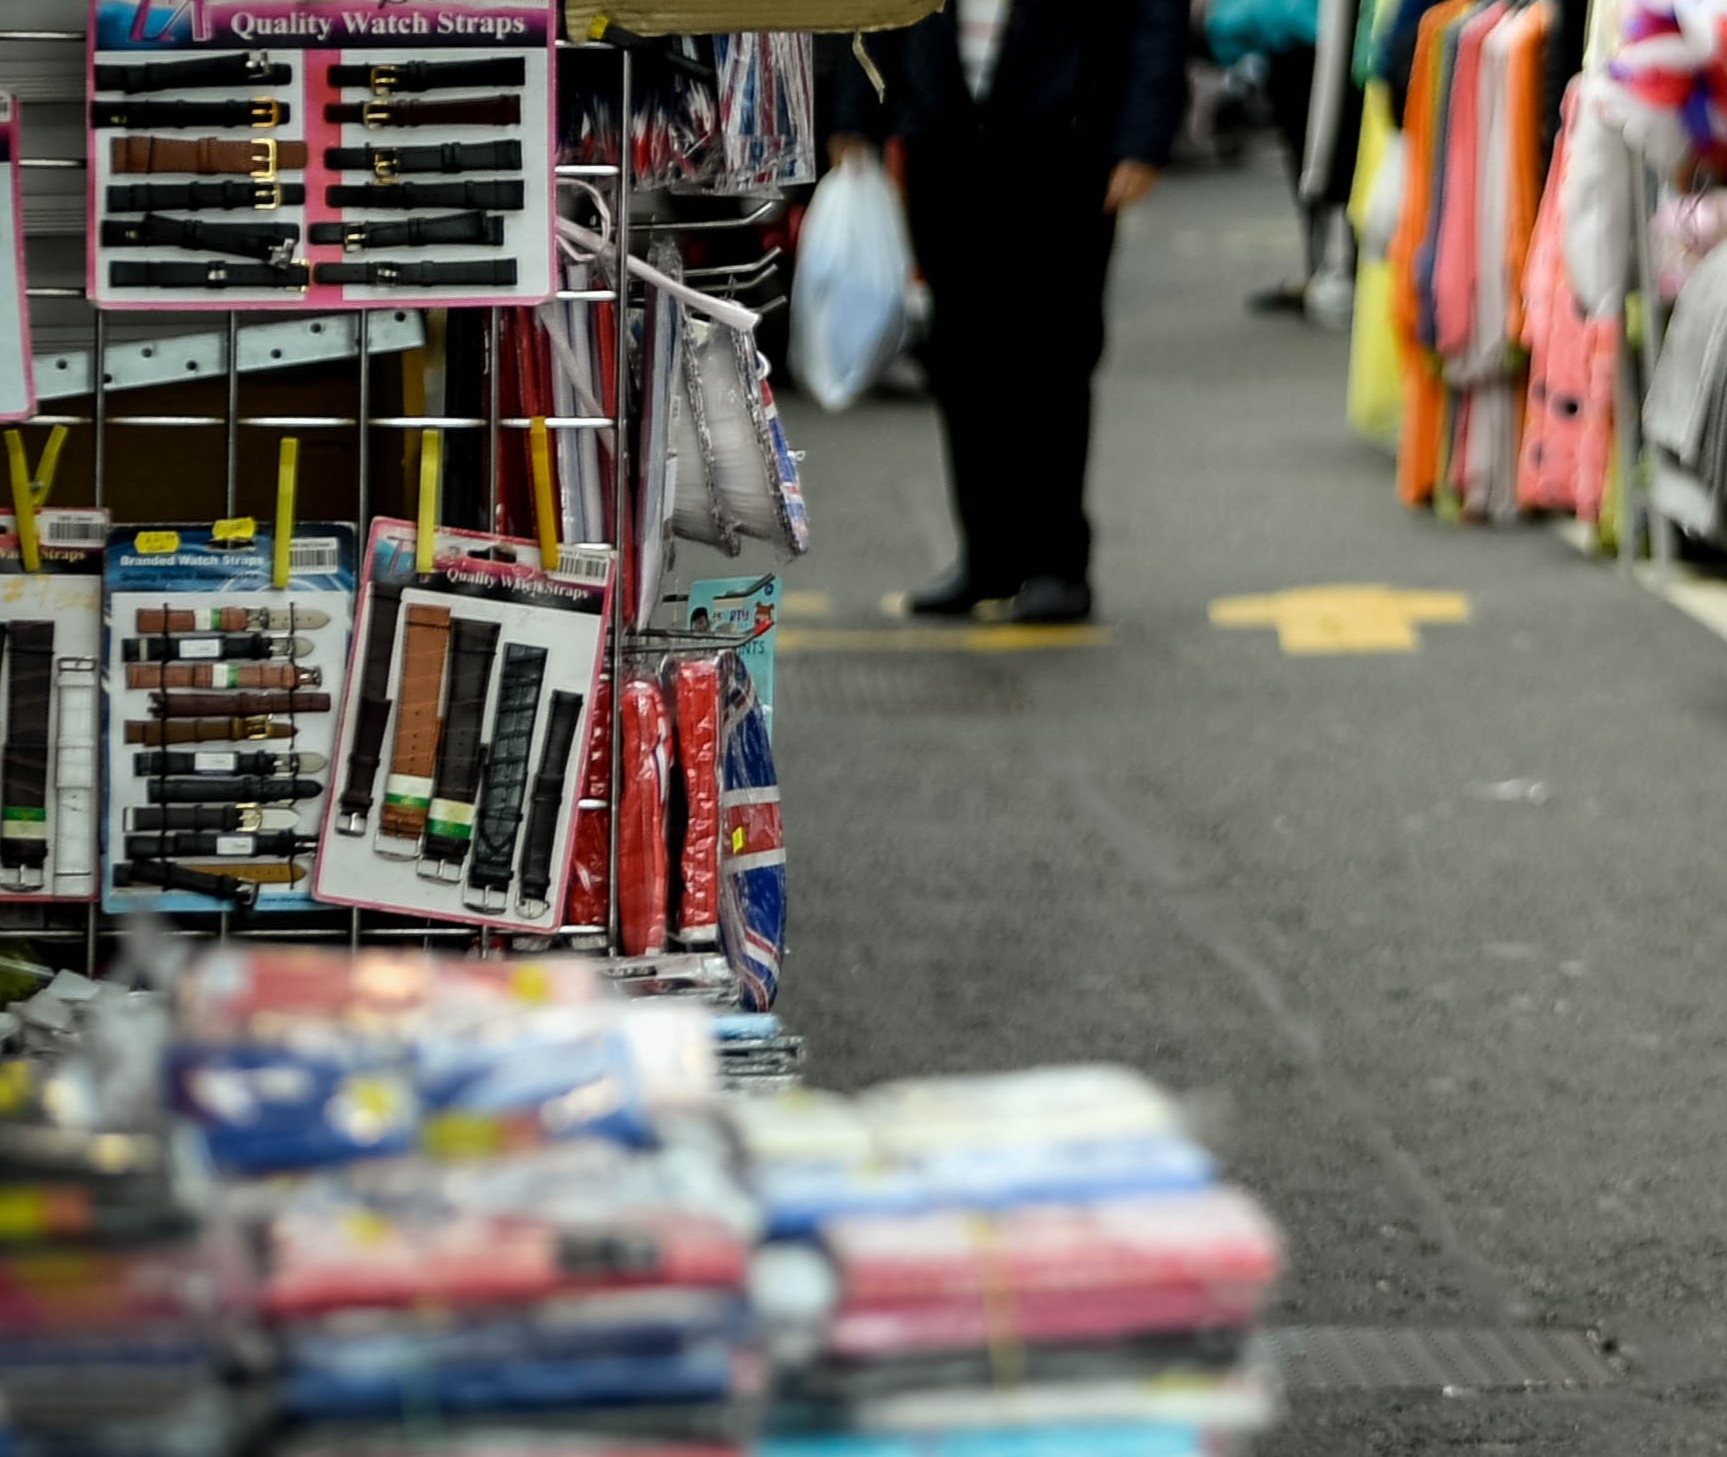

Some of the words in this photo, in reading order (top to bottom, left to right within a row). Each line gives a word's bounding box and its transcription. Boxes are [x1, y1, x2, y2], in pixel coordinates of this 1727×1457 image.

[230, 11, 332, 40] Quality
[341, 11, 429, 36] Watch
[436, 9, 526, 38] Straps
[119, 553, 176, 567] Branded
[178, 554, 219, 567] Watch
[221, 553, 264, 569] Straps
[446, 566, 496, 589] Quality
[544, 577, 590, 601] Straps
